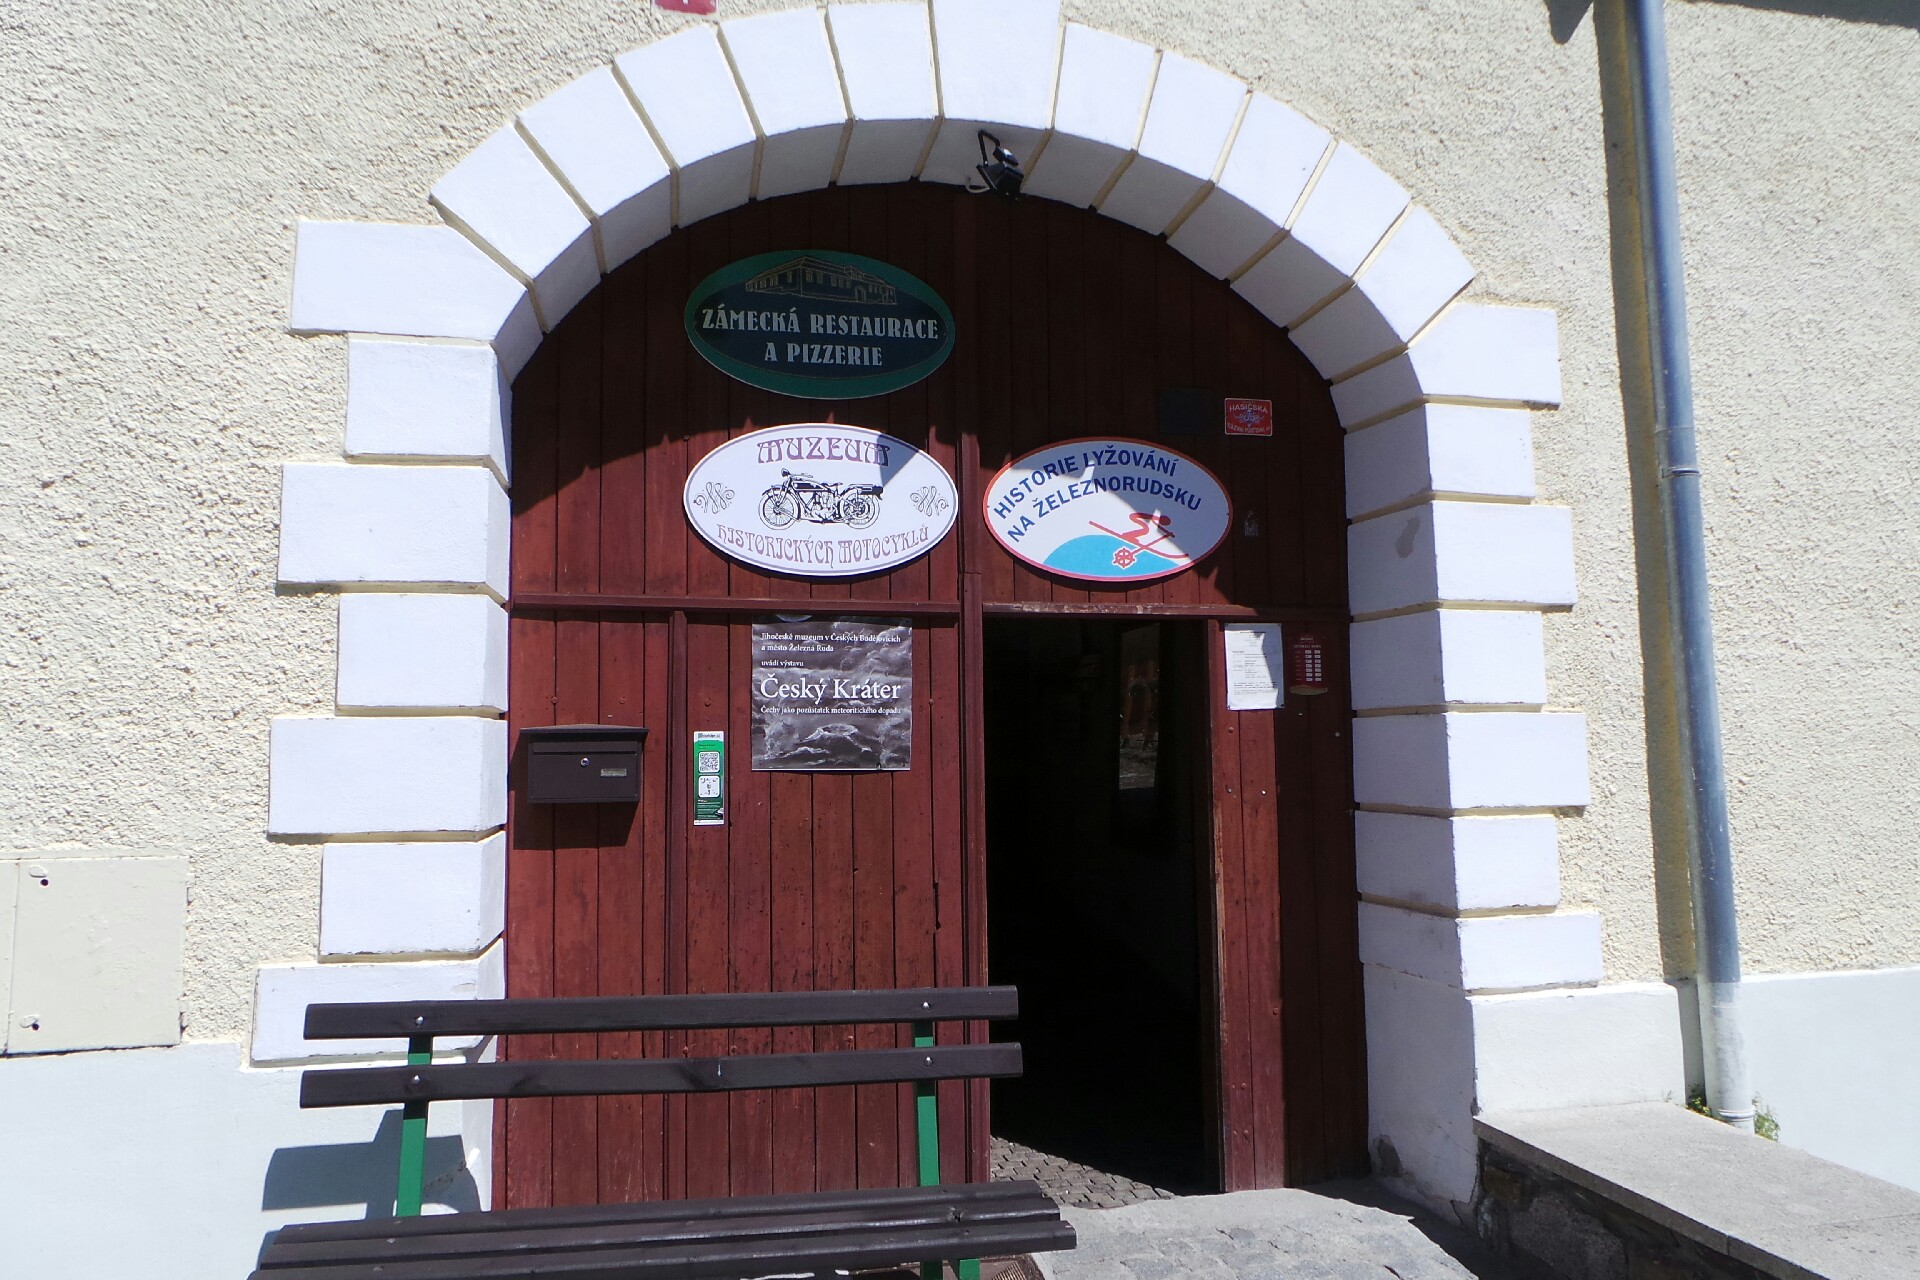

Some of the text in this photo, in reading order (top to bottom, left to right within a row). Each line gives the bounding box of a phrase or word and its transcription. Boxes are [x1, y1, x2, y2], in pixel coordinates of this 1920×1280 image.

[701, 303, 939, 340] ZÁMECKÁ RESTAURACE
[764, 342, 882, 366] A PIZZERIE
[757, 436, 891, 467] MUZEUM
[993, 445, 1180, 519] HISTORIE LYŽOVÁNÍ
[1007, 476, 1202, 543] NA ŽELEZNORUDSKU
[717, 523, 929, 568] HISTORICKÝCH MOTOCYKLŮ
[761, 632, 793, 642] Jihočeské
[830, 633, 859, 644] Českých
[767, 644, 787, 652] město
[789, 643, 815, 652] Železná
[780, 660, 804, 668] výstavu
[761, 673, 901, 705] Český Kráter
[760, 705, 780, 715] Čechy
[781, 706, 795, 715] jako
